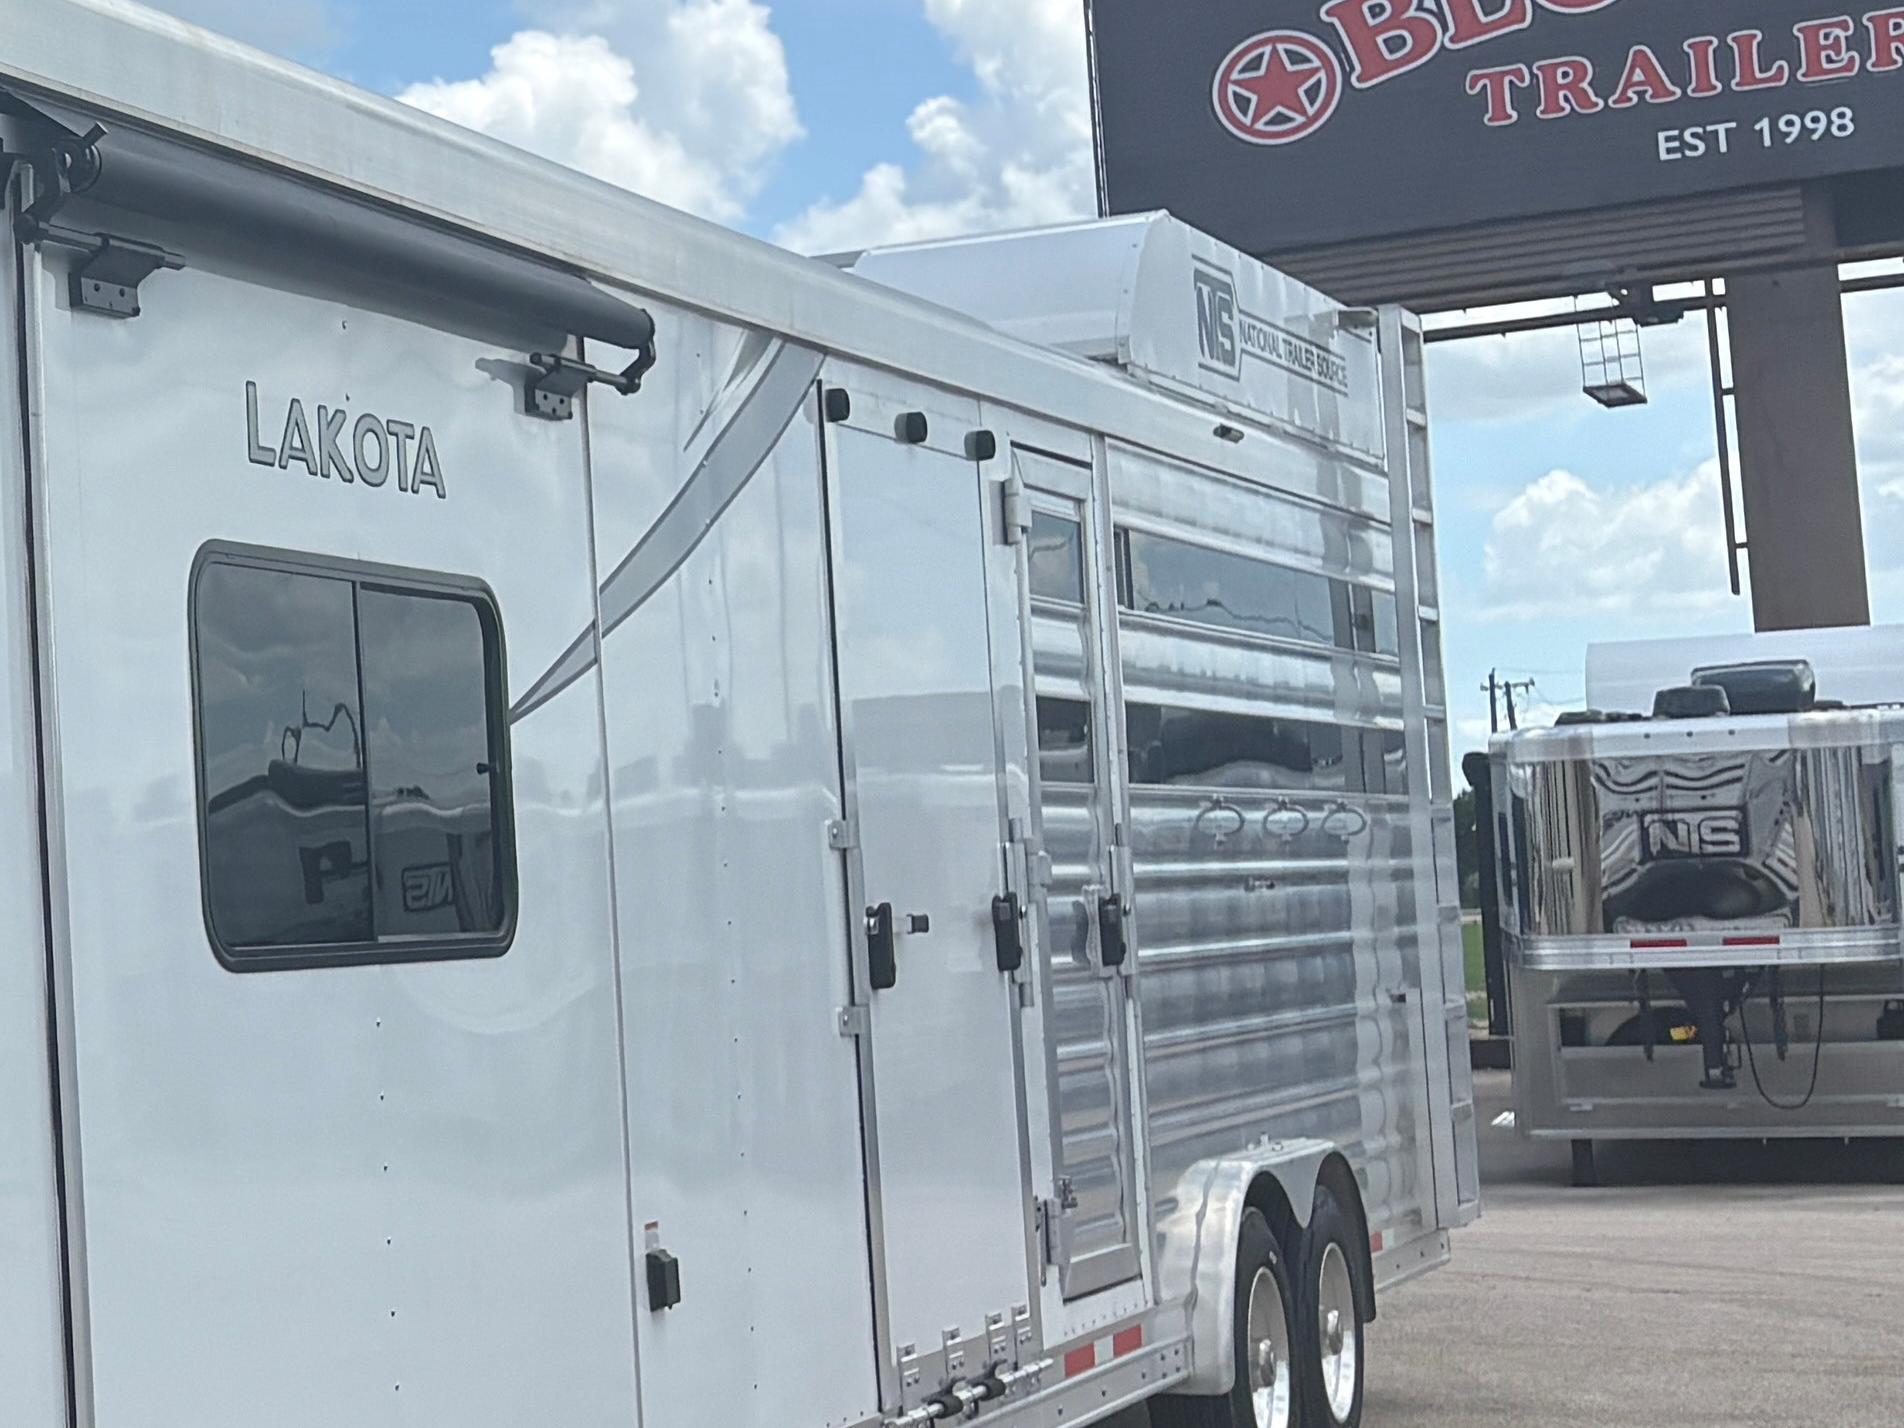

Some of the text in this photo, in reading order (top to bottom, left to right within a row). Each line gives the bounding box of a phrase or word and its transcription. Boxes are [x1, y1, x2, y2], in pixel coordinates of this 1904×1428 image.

[1656, 105, 1855, 162] EST 1998
[1193, 266, 1237, 369] NTS
[1240, 318, 1349, 389] NATIONAL TRAILER SOURCE
[245, 379, 447, 500] LAKOTA
[1643, 810, 1743, 856] NTS
